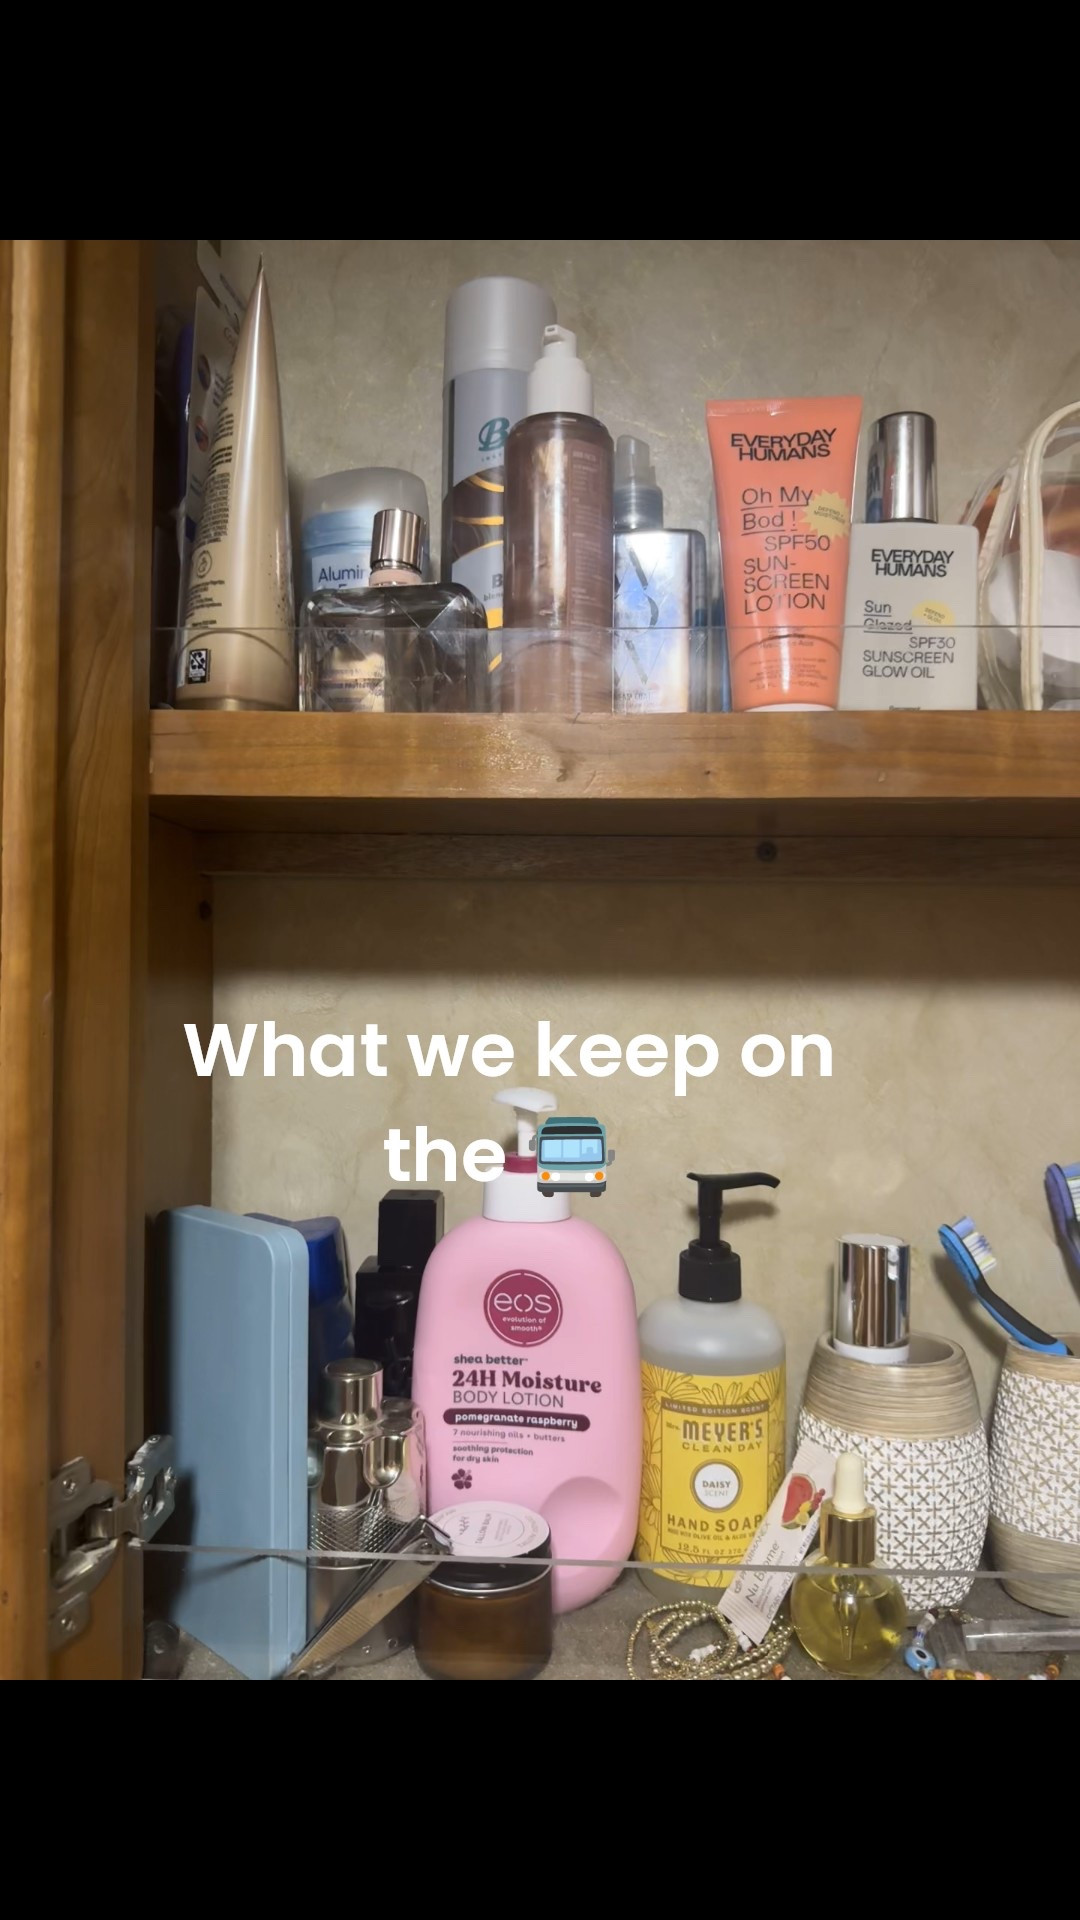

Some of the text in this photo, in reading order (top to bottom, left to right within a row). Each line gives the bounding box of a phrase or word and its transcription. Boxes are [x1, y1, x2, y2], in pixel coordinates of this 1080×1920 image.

[731, 428, 837, 448] EVERYDAY
[739, 443, 831, 462] HUMANS
[742, 486, 813, 506] Oh My
[743, 511, 784, 531] Bod
[764, 535, 831, 551] SPF50
[871, 548, 954, 564] EVERYDAY
[743, 555, 797, 575] SUN-
[875, 562, 947, 578] HUMANS
[743, 573, 830, 595] SCREEN
[743, 592, 826, 615] LOTION
[864, 599, 892, 614] Sun
[864, 617, 913, 632] Glazed
[908, 636, 956, 649] SPF30
[862, 649, 955, 664] SUNSCREEN
[862, 664, 935, 679] GLOW OIL
[494, 1292, 553, 1314] eos
[502, 1315, 547, 1324] evolution of
[454, 1354, 483, 1365] shea
[452, 1369, 602, 1394] 24H Moisture
[453, 1390, 564, 1408] BODY LOTION
[664, 1402, 698, 1413] LIMITED
[455, 1412, 578, 1430] pomegranate raspberry
[460, 1428, 507, 1439] nourishing
[508, 1430, 524, 1439] oils
[533, 1432, 566, 1443] butters
[683, 1418, 763, 1442] MEYER'S
[452, 1444, 534, 1456] soothing protection
[682, 1440, 762, 1453] CLEAN DAY
[452, 1454, 499, 1463] for dry skin
[702, 1480, 731, 1489] DAISY
[704, 1489, 729, 1497] SCENT
[667, 1513, 763, 1532] HAND SOAP
[693, 1532, 711, 1541] OLIVE
[677, 1542, 700, 1554] 12.5
[745, 1582, 760, 1604] Nu
